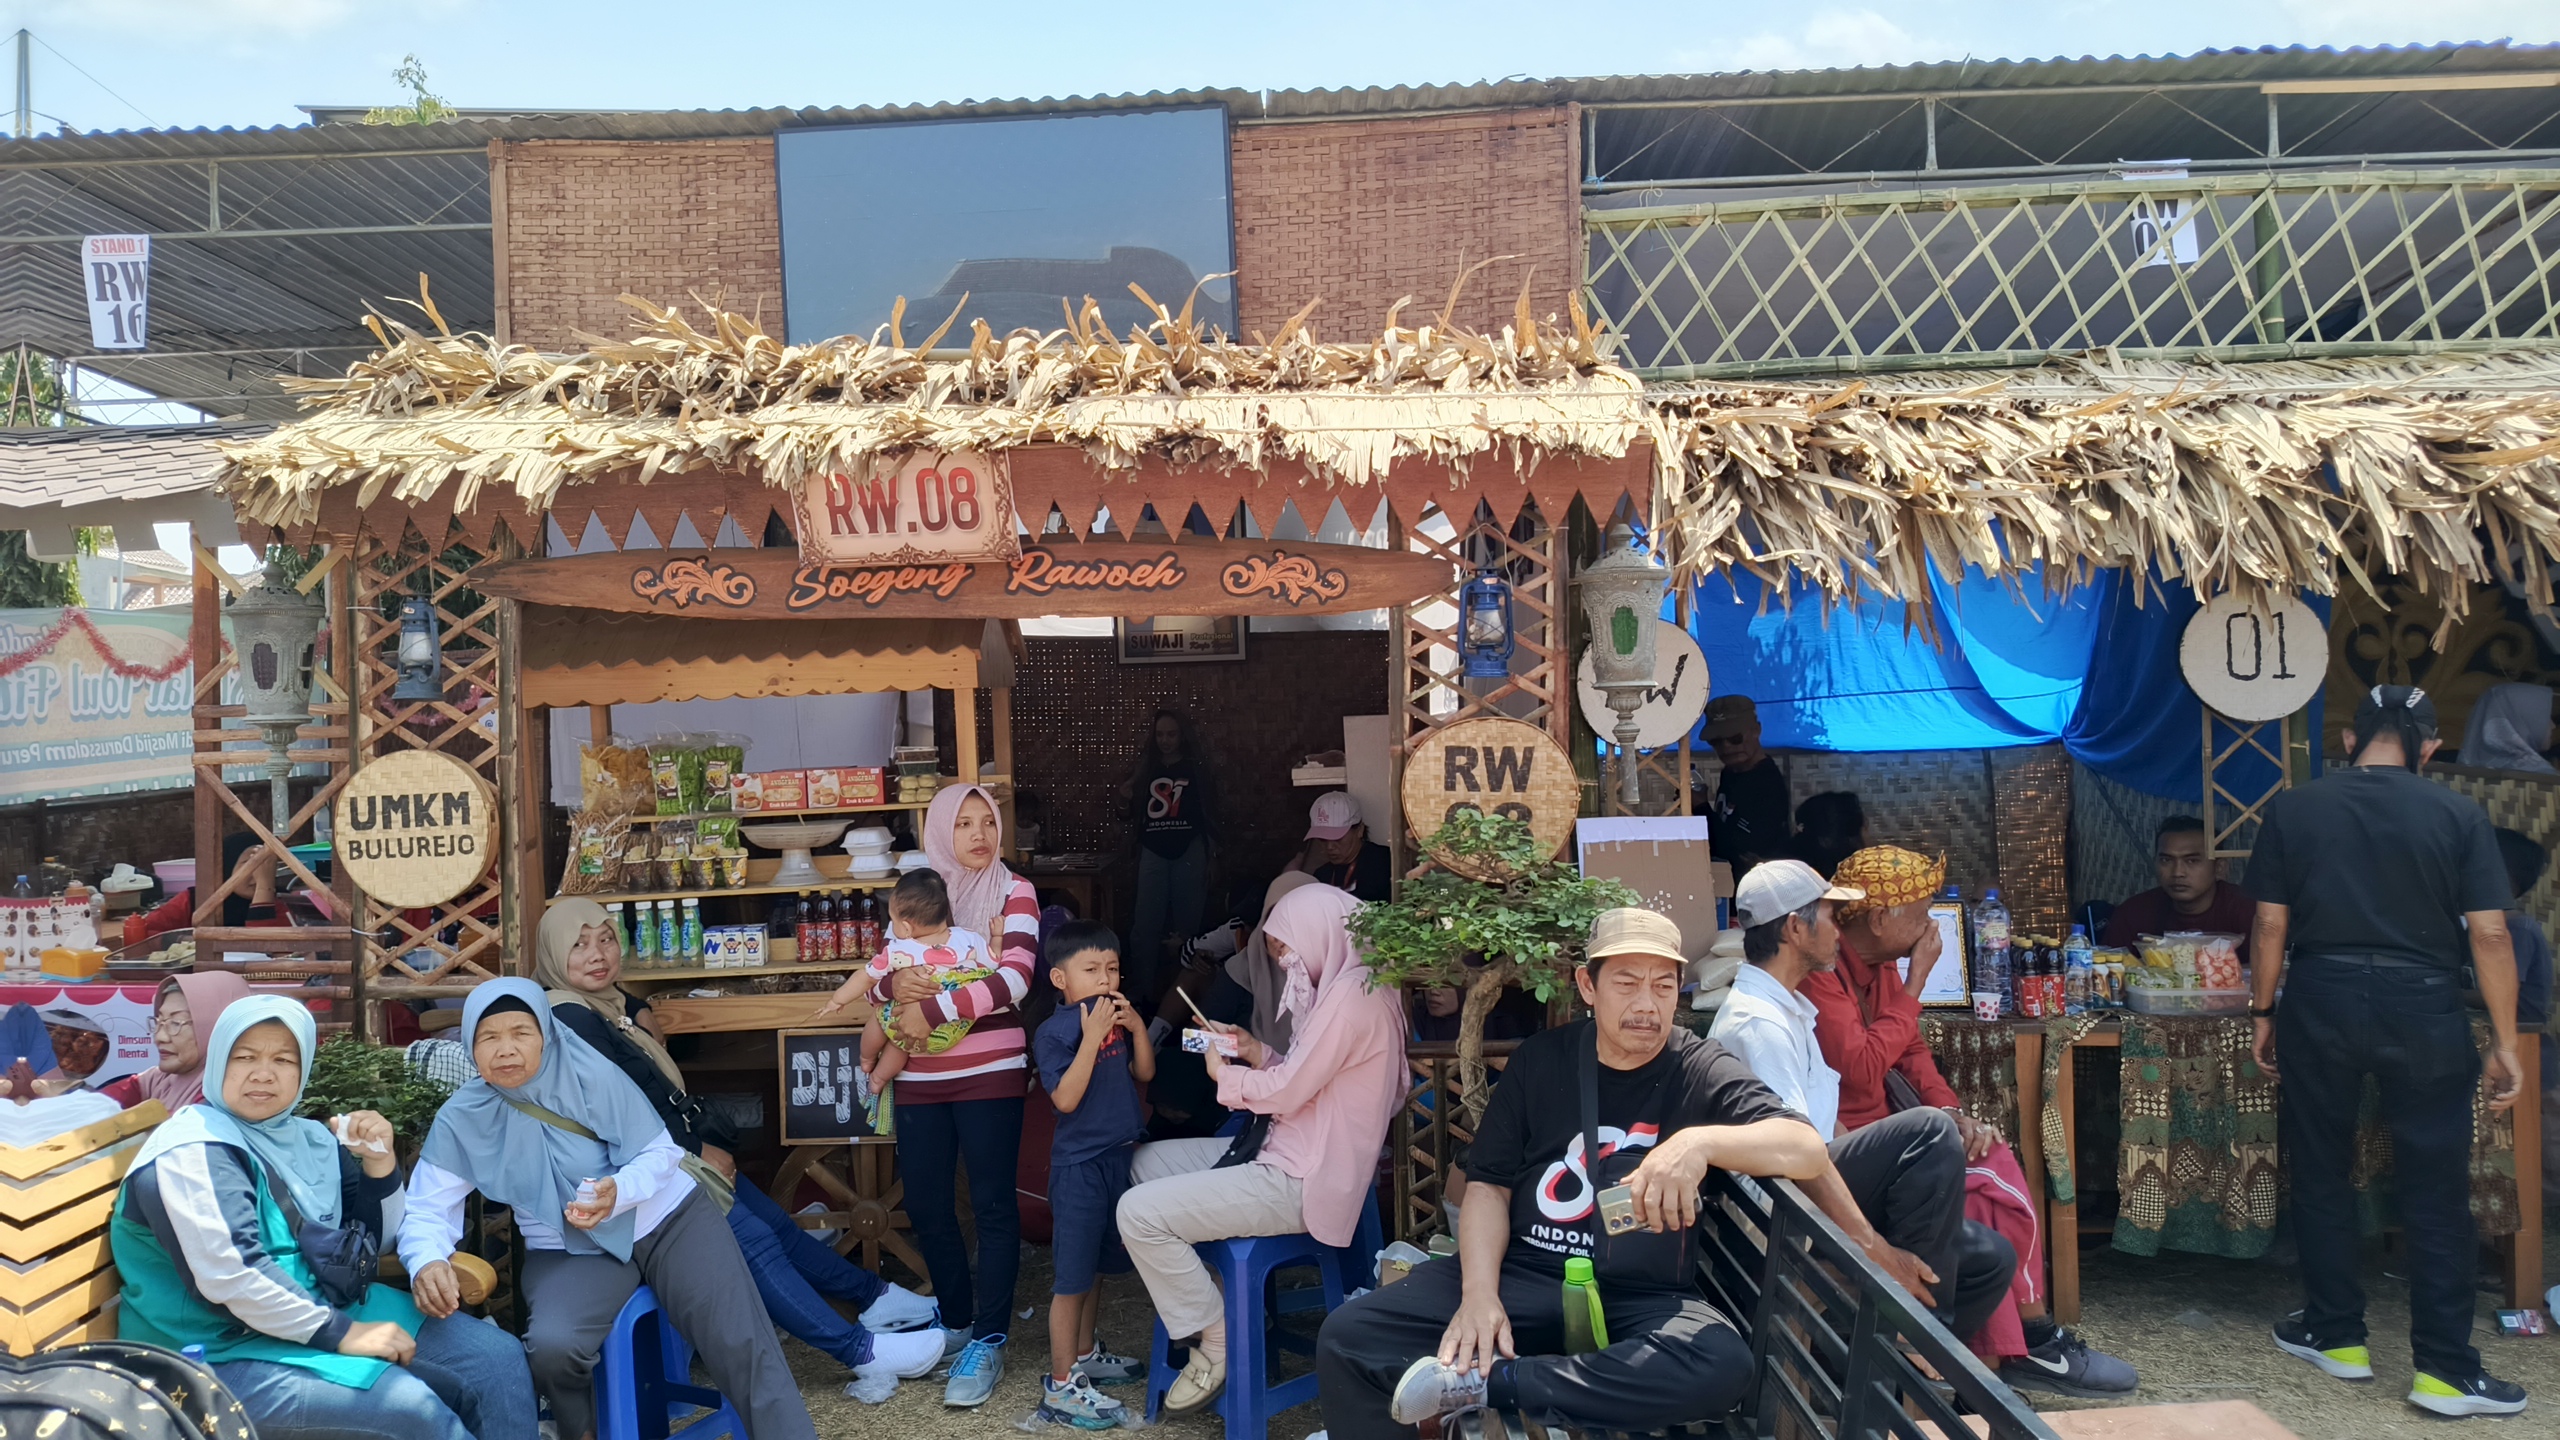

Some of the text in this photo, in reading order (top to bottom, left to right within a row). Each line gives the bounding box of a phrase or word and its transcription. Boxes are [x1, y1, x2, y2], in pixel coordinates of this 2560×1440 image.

[91, 239, 136, 254] STAND
[91, 261, 147, 302] RW
[825, 466, 981, 535] RW.08
[1130, 633, 1184, 649] SUWAJI
[2226, 611, 2296, 681] 01
[1444, 745, 1535, 793] RW
[349, 791, 471, 831] UMKM
[348, 834, 475, 861] BULUREJO
[117, 1034, 152, 1045] Dimsum
[117, 1048, 149, 1059] Mentai
[1568, 1246, 1591, 1258] ADIL
